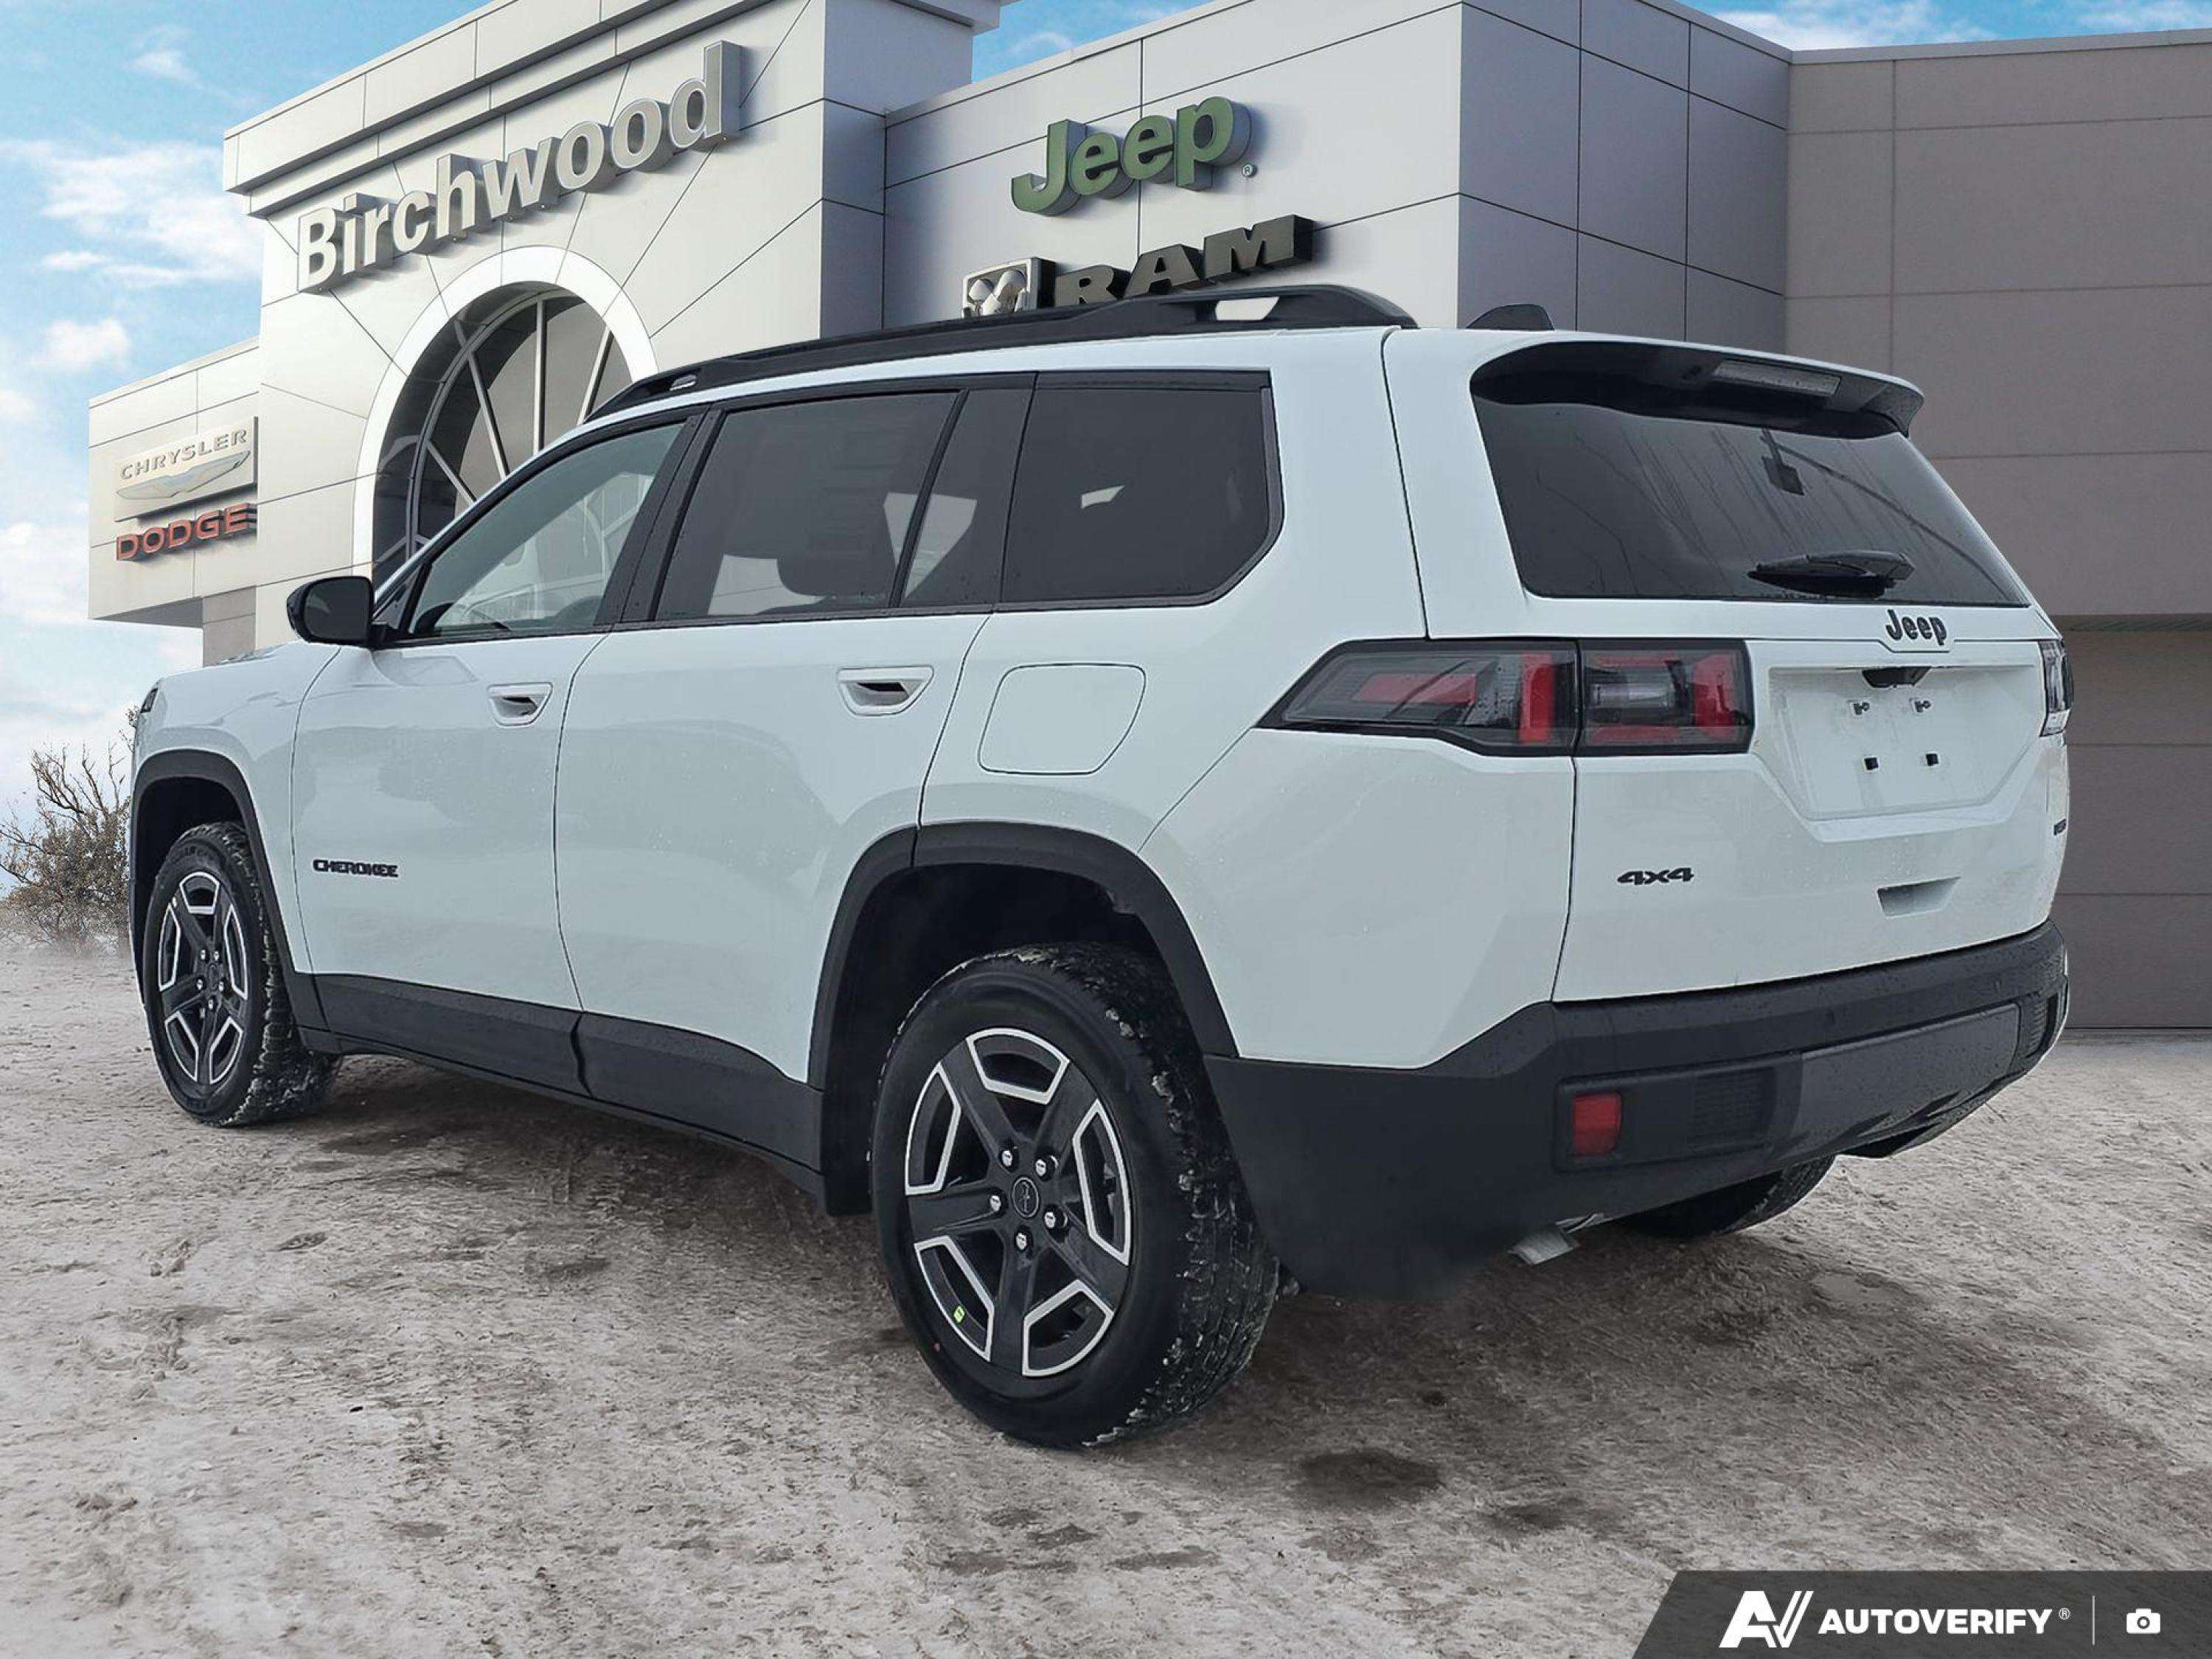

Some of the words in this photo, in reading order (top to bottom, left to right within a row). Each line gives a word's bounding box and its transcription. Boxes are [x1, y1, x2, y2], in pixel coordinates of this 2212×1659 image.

[298, 40, 740, 293] Birchwood
[1011, 96, 1251, 215] Jeep
[1055, 215, 1315, 307] RAM
[120, 428, 248, 480] CHRYSLER
[116, 503, 257, 561] DODGE
[1885, 608, 1947, 646] Jeep
[313, 859, 399, 877] CHEROKEE
